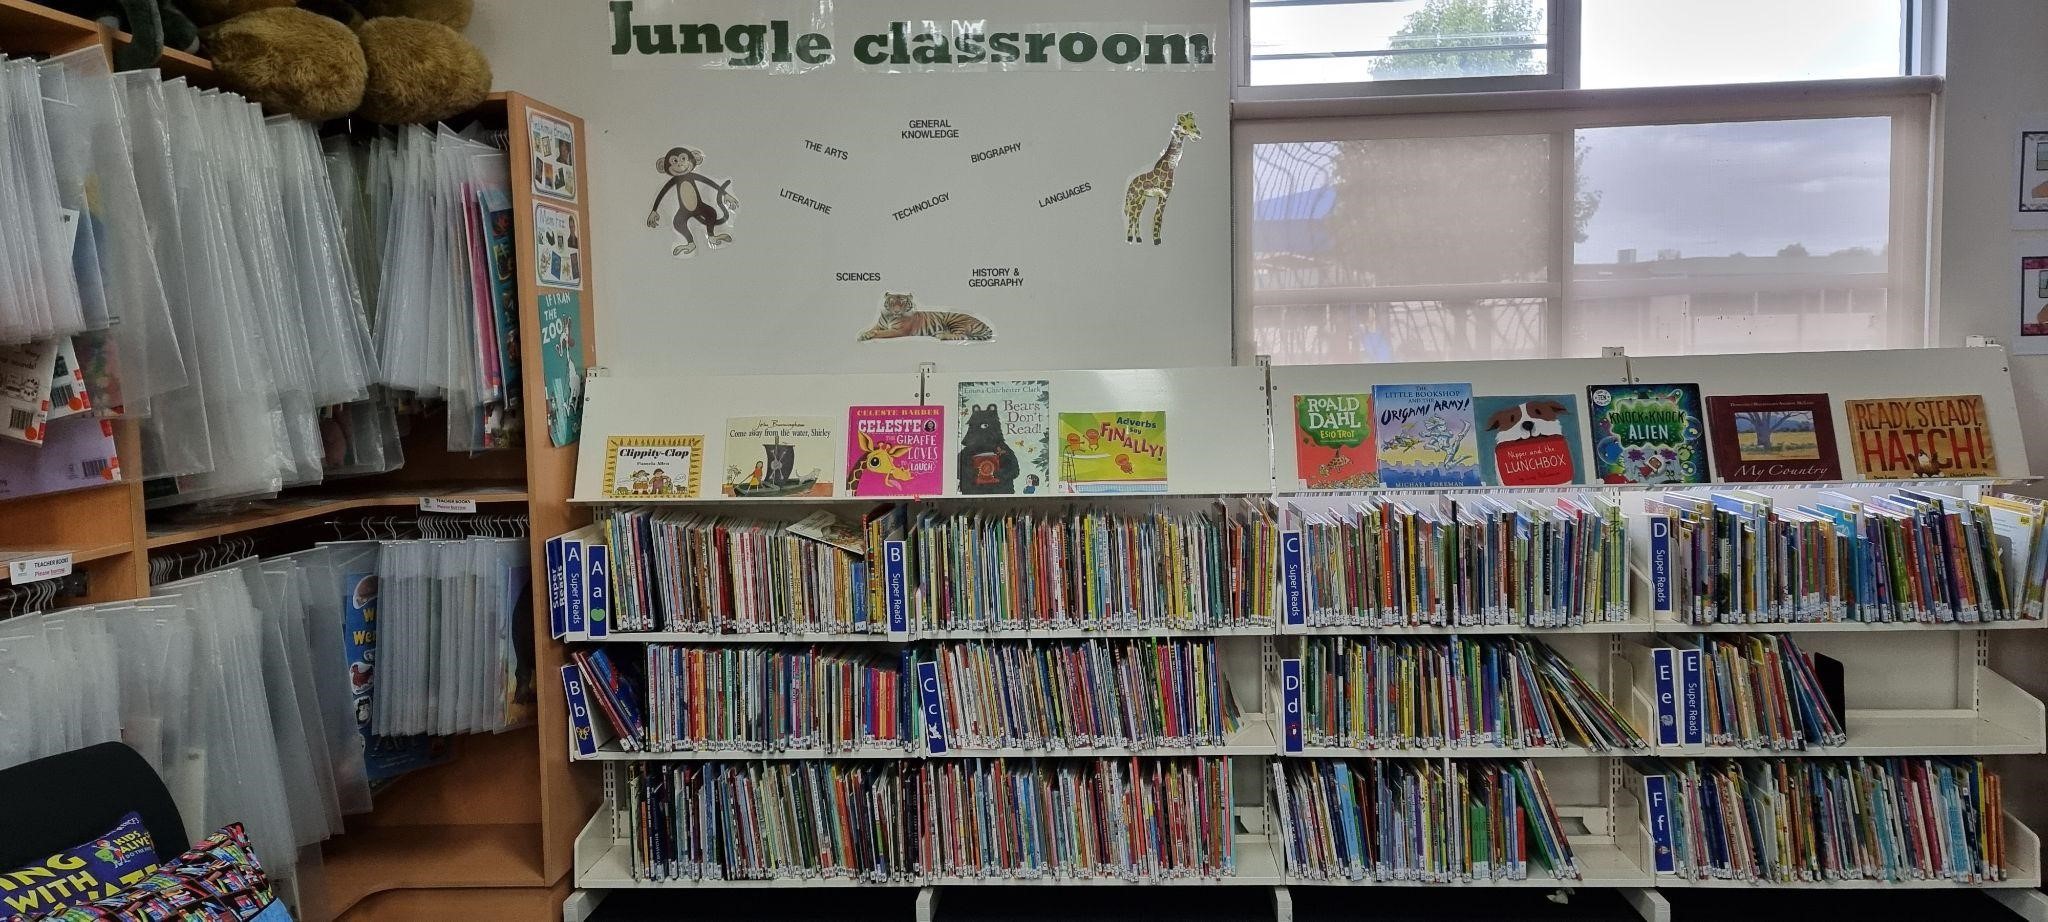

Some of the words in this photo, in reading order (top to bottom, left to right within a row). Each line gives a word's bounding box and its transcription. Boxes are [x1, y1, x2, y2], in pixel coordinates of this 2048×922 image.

[609, 0, 833, 66] Jungle
[853, 21, 1214, 65] classroom
[908, 119, 951, 128] GENERAL
[901, 129, 959, 139] KNOWLEDGE
[804, 139, 823, 152] THE
[824, 146, 849, 160] ARTS
[970, 142, 1022, 163] BIOGRAPHY
[779, 188, 832, 215] LITERATURE
[1038, 182, 1092, 208] LANGUAGES
[892, 192, 951, 221] TECHNOLOGY
[835, 272, 881, 282] SCIENCES
[972, 268, 1010, 277] HISTORY
[1013, 268, 1020, 277] &
[968, 278, 1024, 288] GEOGRAPHY
[545, 294, 553, 307] IF
[556, 292, 571, 304] RAN
[544, 308, 558, 320] THE
[541, 318, 563, 345] ZOO
[1415, 390, 1460, 398] BOOKSHOP
[901, 408, 940, 416] BARBER
[1003, 400, 1041, 411] Bears
[1307, 396, 1360, 412] ROALD
[1381, 404, 1431, 426] ORIGAMI
[1433, 398, 1470, 412] ARMY!
[1008, 411, 1042, 423] Don't
[1116, 416, 1157, 428] Adverbs
[1308, 411, 1361, 429] DAHL
[1855, 401, 1915, 430] READY,
[1915, 399, 1982, 428] STEADY,
[729, 429, 747, 437] Come
[748, 430, 762, 438] away
[764, 428, 778, 437] from
[780, 428, 790, 437] the
[792, 429, 810, 438] water,
[811, 428, 831, 438] Shirley
[858, 419, 922, 433] CELESTE
[1005, 422, 1042, 435] Read!
[1320, 430, 1336, 439] ESIO
[1337, 429, 1355, 438] TROT
[1628, 424, 1669, 440] ALIEN
[896, 434, 937, 446] GIRAFFE
[1100, 422, 1164, 461] FINALLY!
[620, 448, 690, 459] Clippity-Clop
[908, 447, 938, 460] LOVES
[1507, 450, 1527, 459] Nipper
[1529, 446, 1542, 455] and
[1544, 443, 1554, 452] the
[1860, 427, 1988, 473] HATCH!
[910, 462, 933, 471] LAUGH
[1504, 454, 1567, 474] LUNCHBOX
[1734, 464, 1765, 481] My
[1768, 463, 1832, 481] Country
[1654, 522, 1668, 538] D
[1287, 537, 1299, 553] C
[568, 547, 580, 562] A
[891, 547, 901, 561] B
[591, 561, 604, 576] A
[1656, 549, 1667, 576] Super
[892, 573, 901, 597] Super
[1289, 564, 1298, 590] Super
[551, 568, 560, 608] Super
[557, 565, 565, 607] Reads
[569, 573, 580, 598] Super
[593, 586, 602, 598] a
[1657, 577, 1667, 603] Reads
[572, 599, 582, 624] Reads
[893, 598, 902, 624] Reads
[1292, 590, 1301, 617] Reads
[1687, 656, 1697, 671] E
[1660, 665, 1670, 681] E
[569, 681, 580, 696] B
[924, 677, 935, 693] C
[1287, 676, 1299, 690] D
[1661, 691, 1671, 705] e
[1688, 683, 1698, 708] Super
[574, 703, 586, 718] b
[928, 703, 938, 715] c
[1288, 698, 1298, 714] d
[1689, 709, 1697, 736] Reads
[1653, 791, 1663, 806] F
[1657, 814, 1665, 831] f
[113, 830, 141, 846] KIDS
[120, 836, 151, 854] ALIVE
[3, 870, 98, 914] WITH
